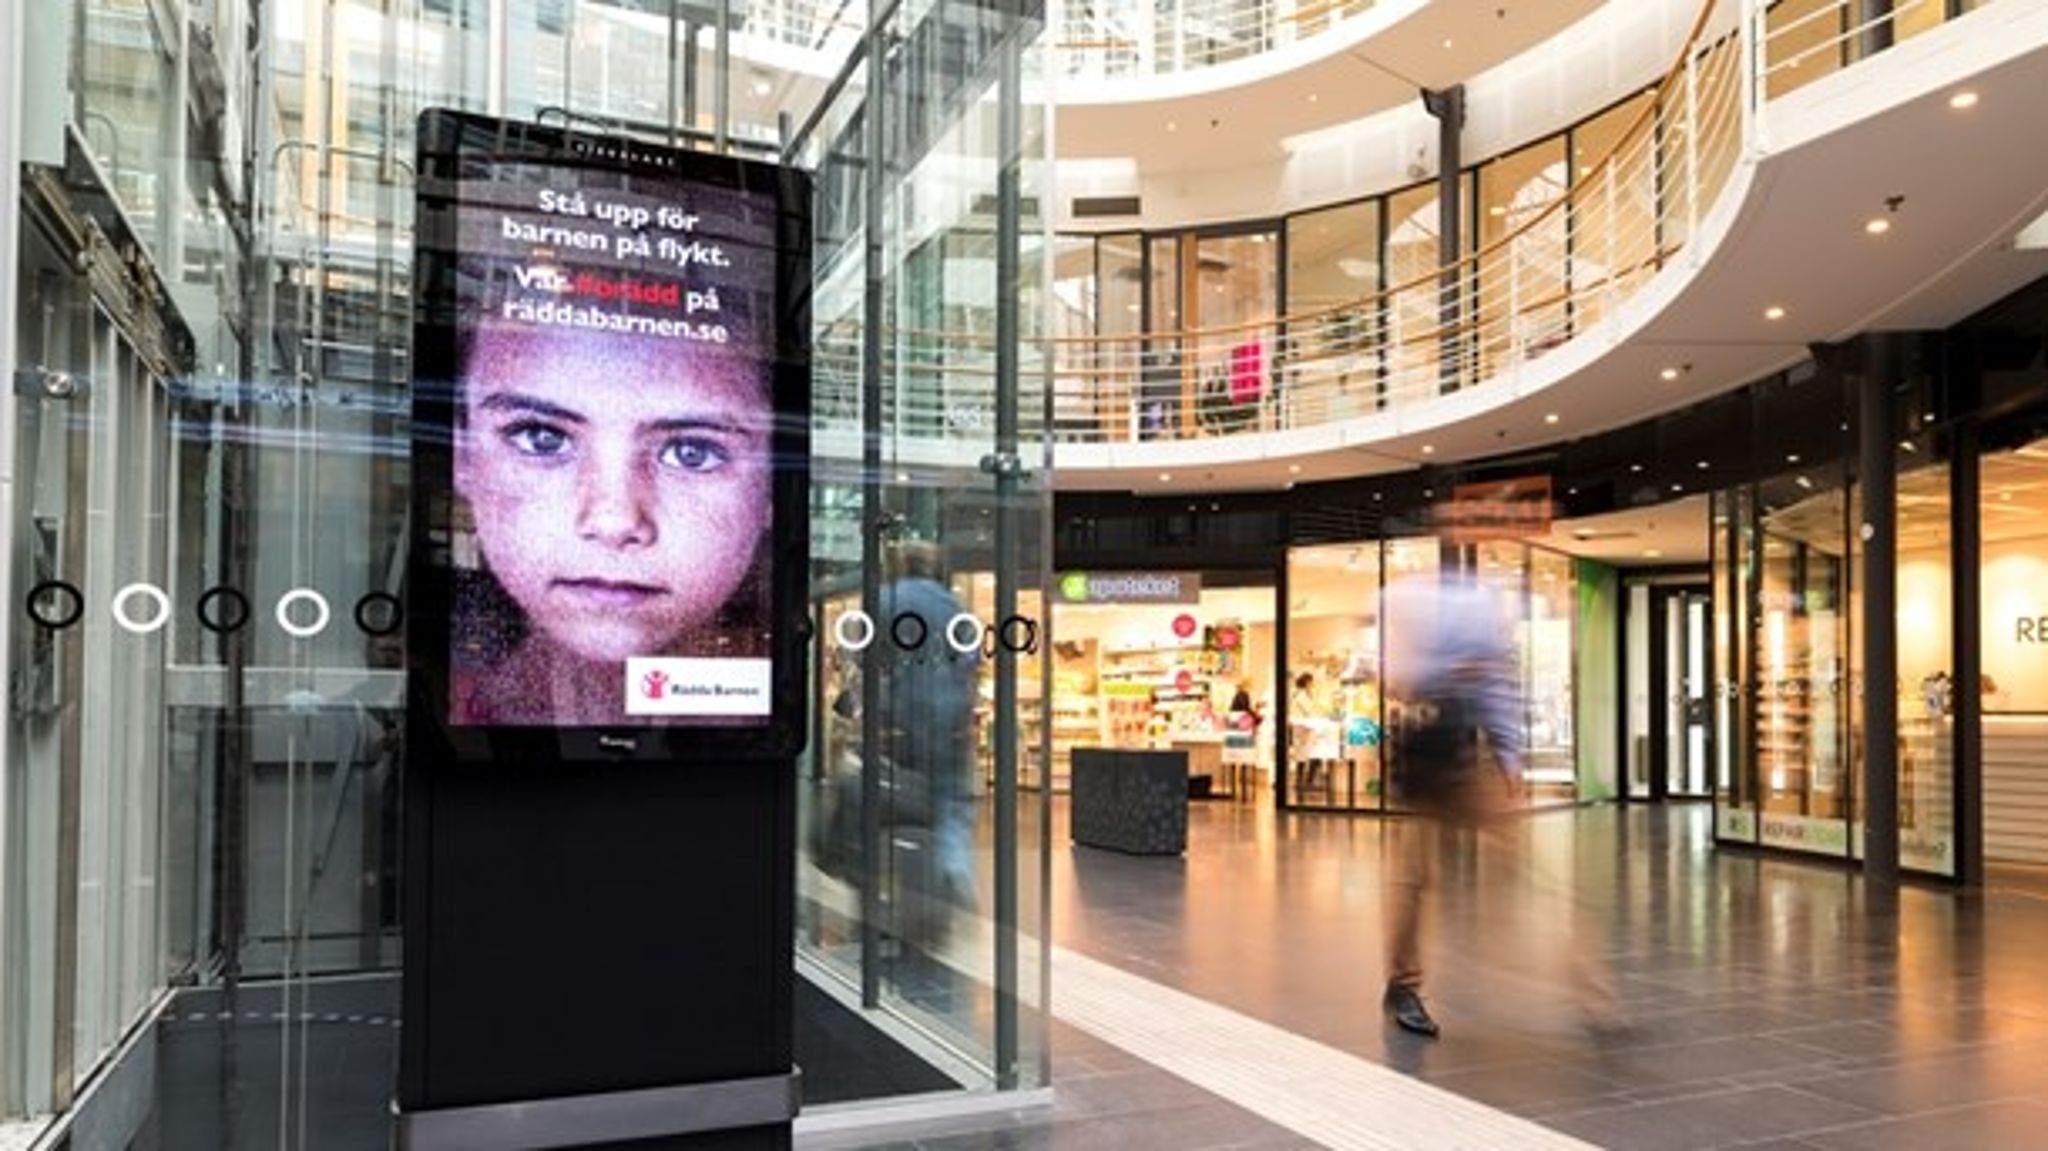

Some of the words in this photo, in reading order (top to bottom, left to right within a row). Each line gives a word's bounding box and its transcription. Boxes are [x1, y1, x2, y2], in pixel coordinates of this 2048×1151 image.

[538, 190, 587, 216] Stå
[595, 202, 650, 229] upp
[658, 205, 700, 231] för
[502, 217, 609, 251] barnen
[617, 231, 652, 260] på
[658, 237, 731, 267] flykt.
[502, 297, 729, 343] räddabarnen.se
[686, 287, 721, 314] på
